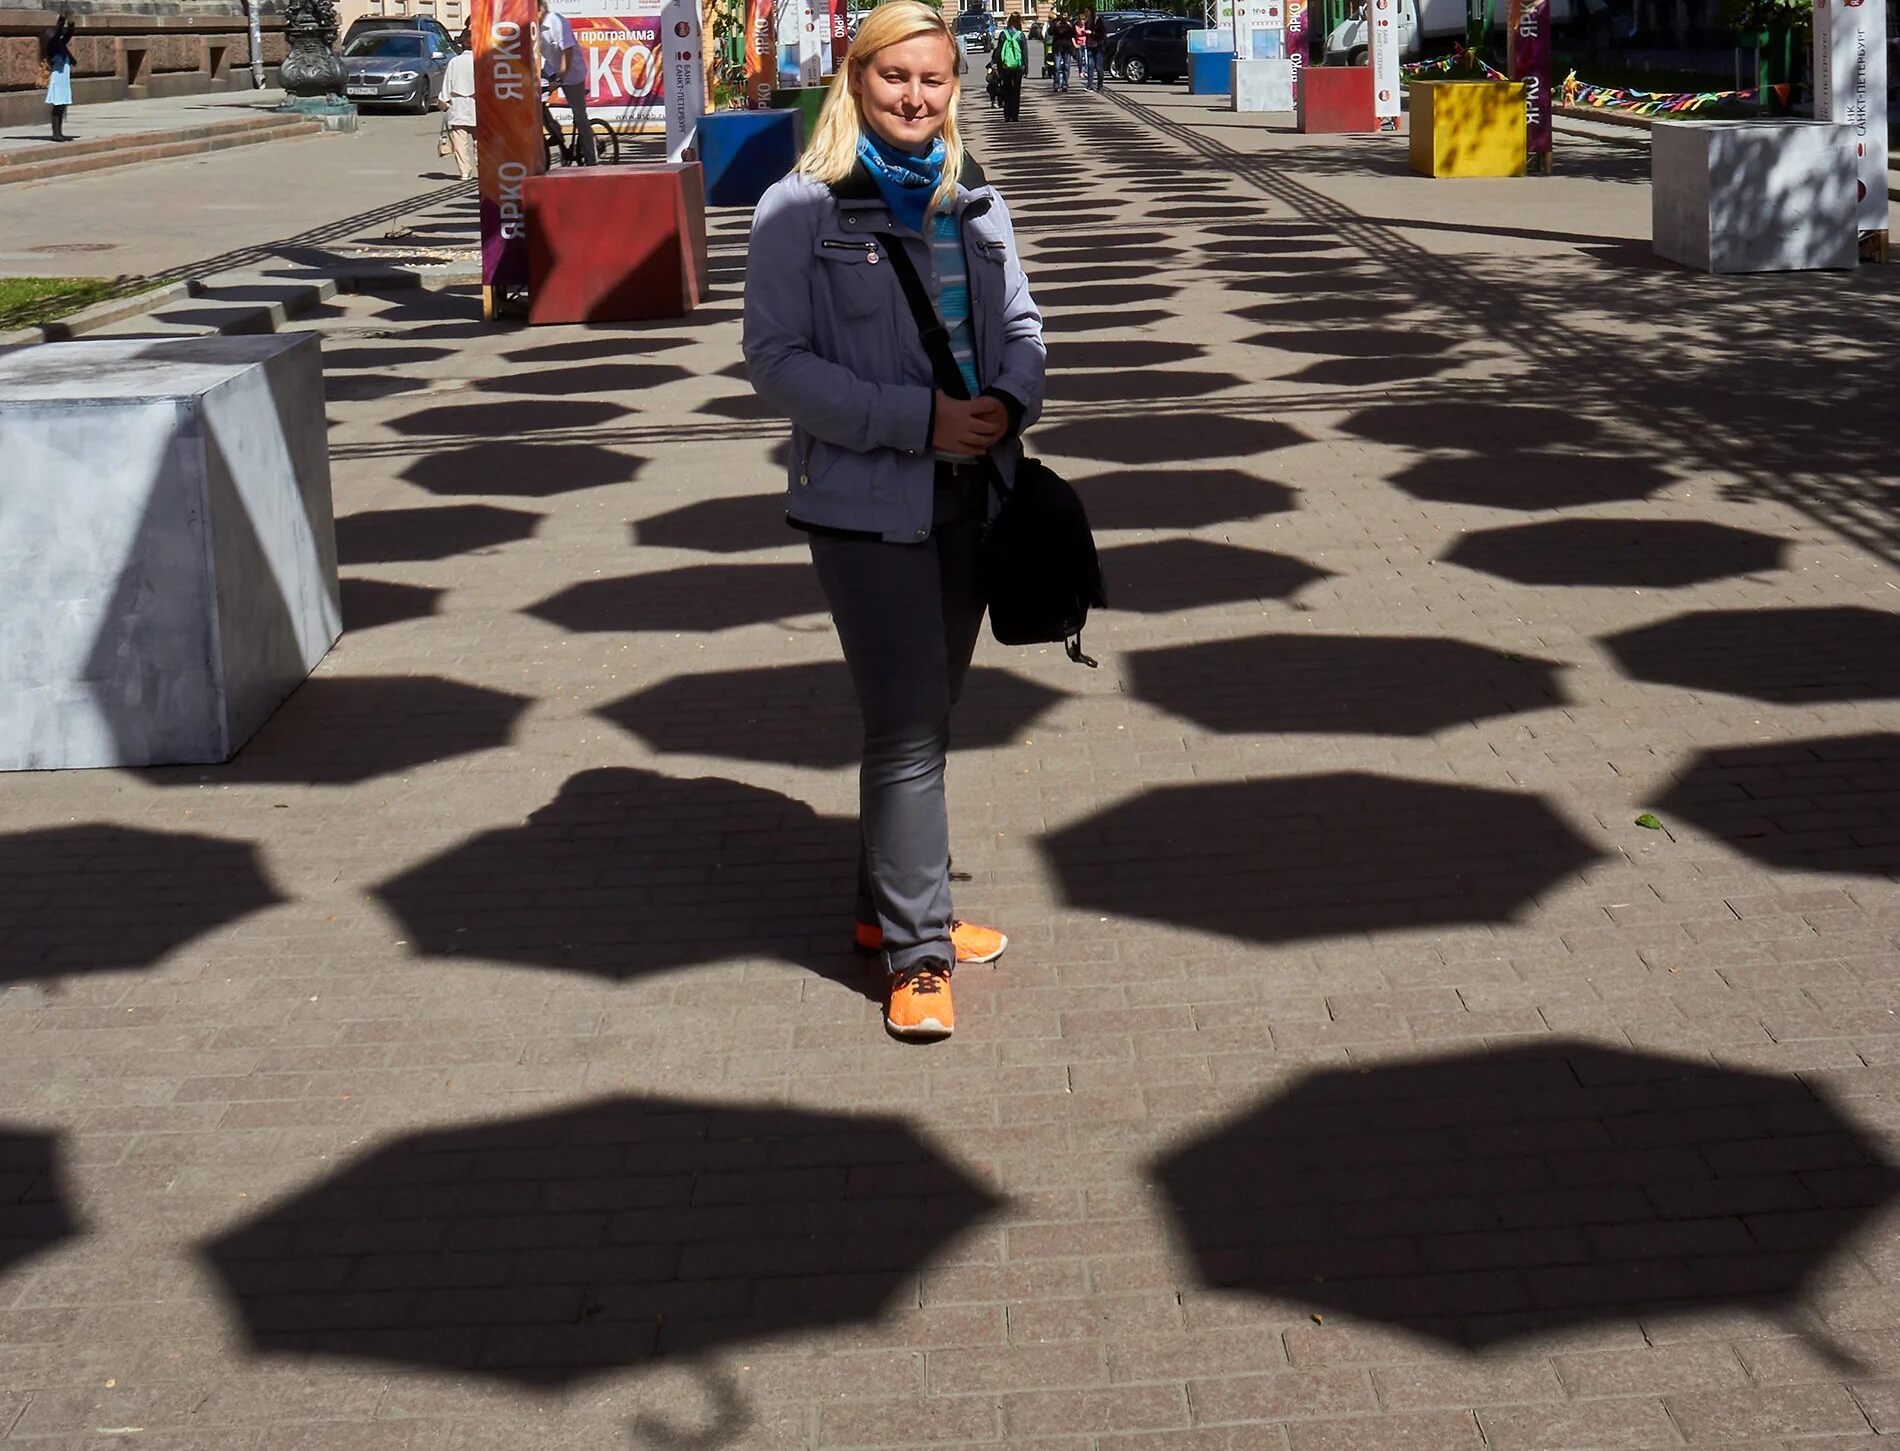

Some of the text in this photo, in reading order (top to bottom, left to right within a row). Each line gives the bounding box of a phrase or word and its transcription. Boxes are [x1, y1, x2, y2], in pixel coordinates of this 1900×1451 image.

[834, 14, 845, 38] ЯРКО
[1289, 2, 1301, 33] ЯРКО
[581, 30, 655, 43] программа
[755, 18, 770, 56] ЯРКО
[491, 21, 524, 101] ЯРКО
[589, 45, 655, 98] КО
[684, 64, 692, 86] БАНК
[675, 64, 686, 133] САНКТ-ПЕТЕРБУРГ
[757, 82, 771, 109] РКО
[1857, 29, 1867, 137] САНКТ-ПЕТЕРБУРГ
[1847, 105, 1855, 124] НК
[497, 161, 527, 240] ЯРКО
